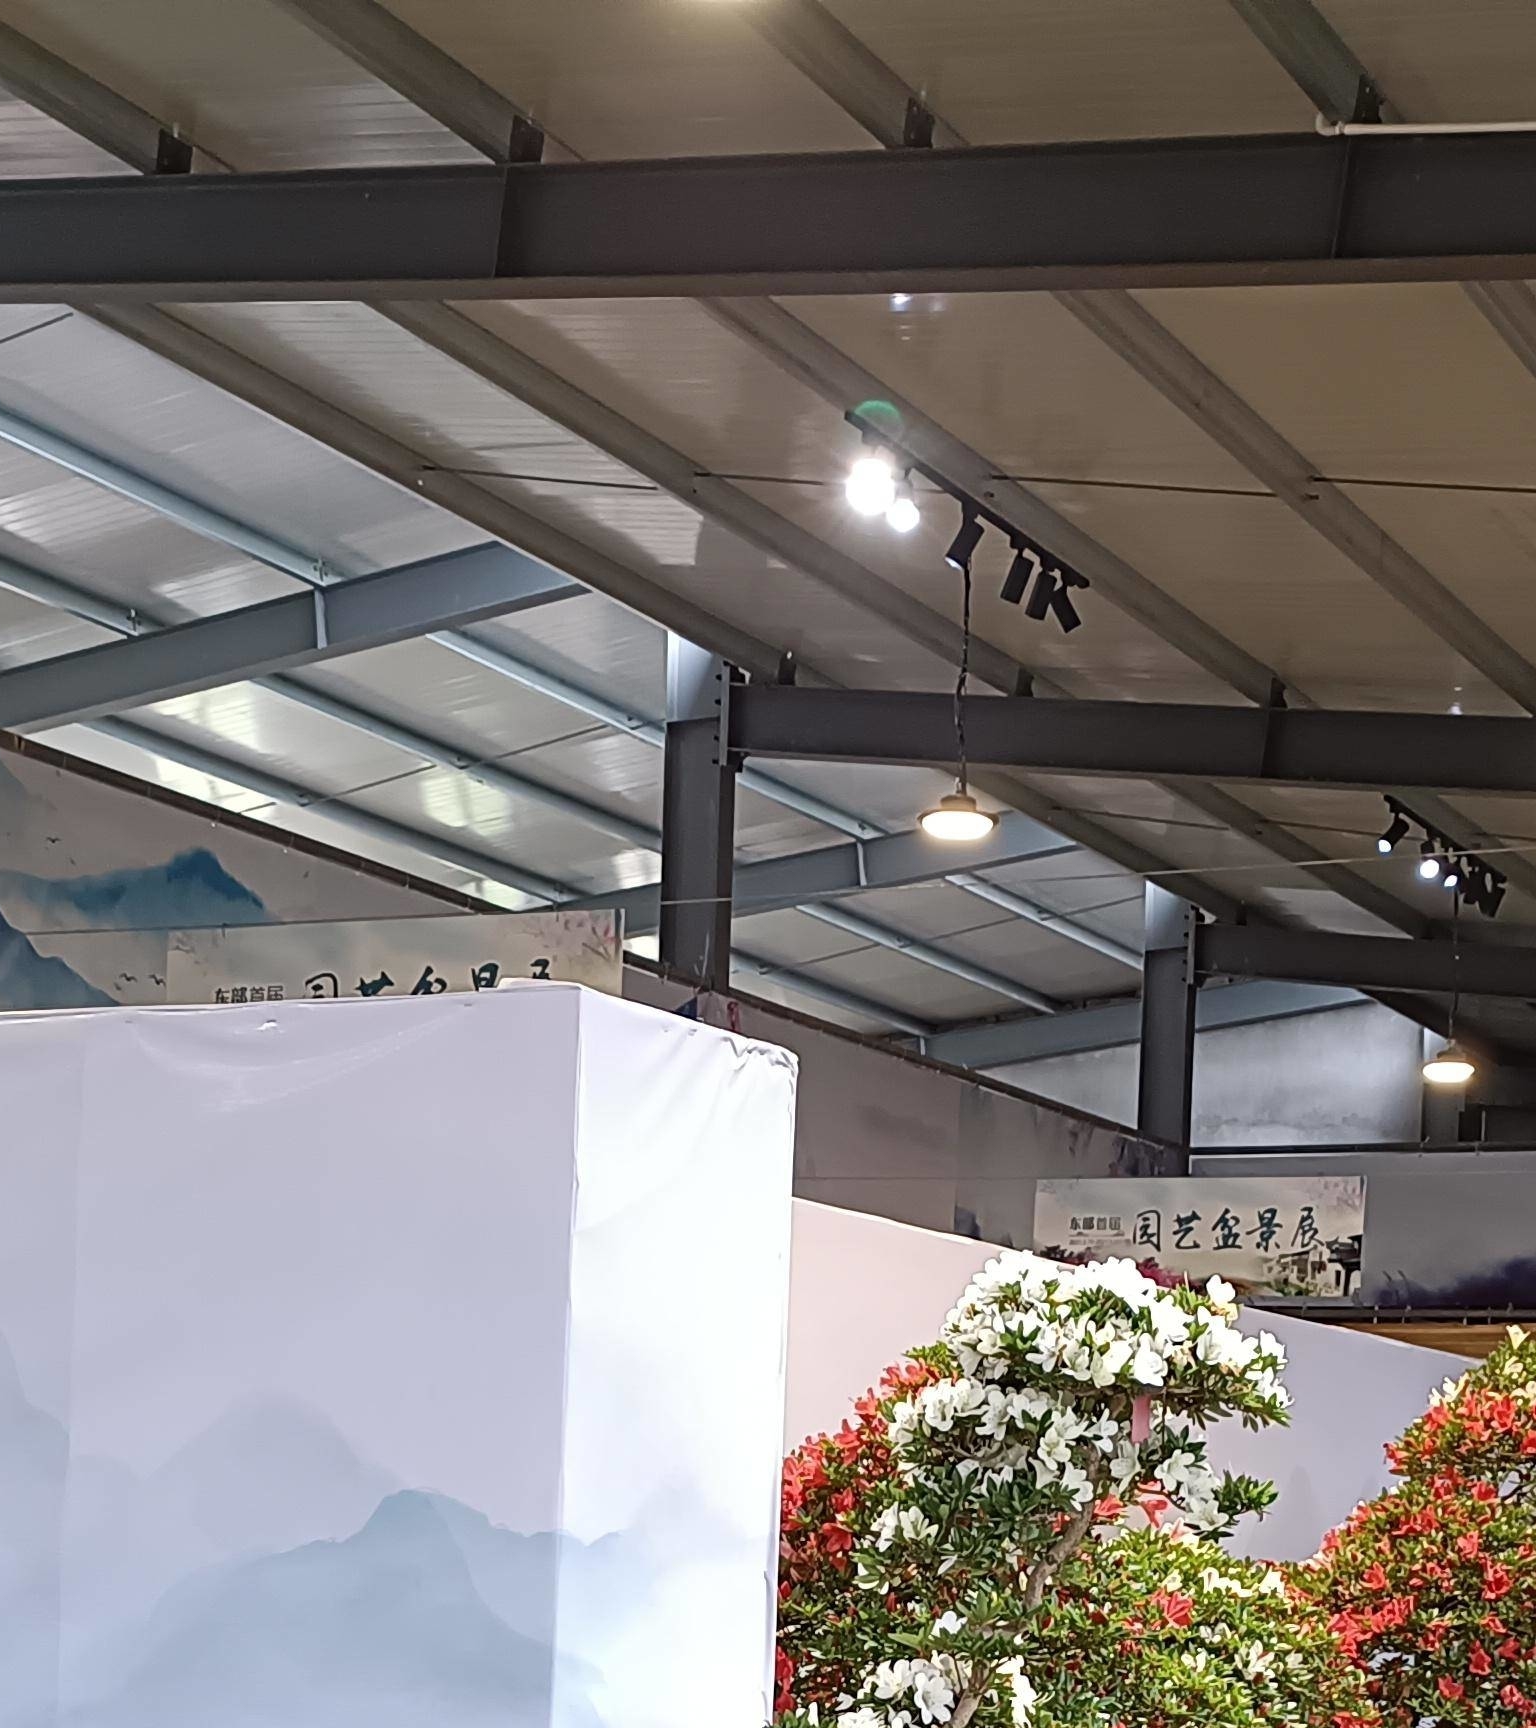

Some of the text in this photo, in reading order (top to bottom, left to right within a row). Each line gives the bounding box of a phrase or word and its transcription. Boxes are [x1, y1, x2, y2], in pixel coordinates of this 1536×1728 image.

[1132, 1206, 1324, 1253] 园艺盆景展
